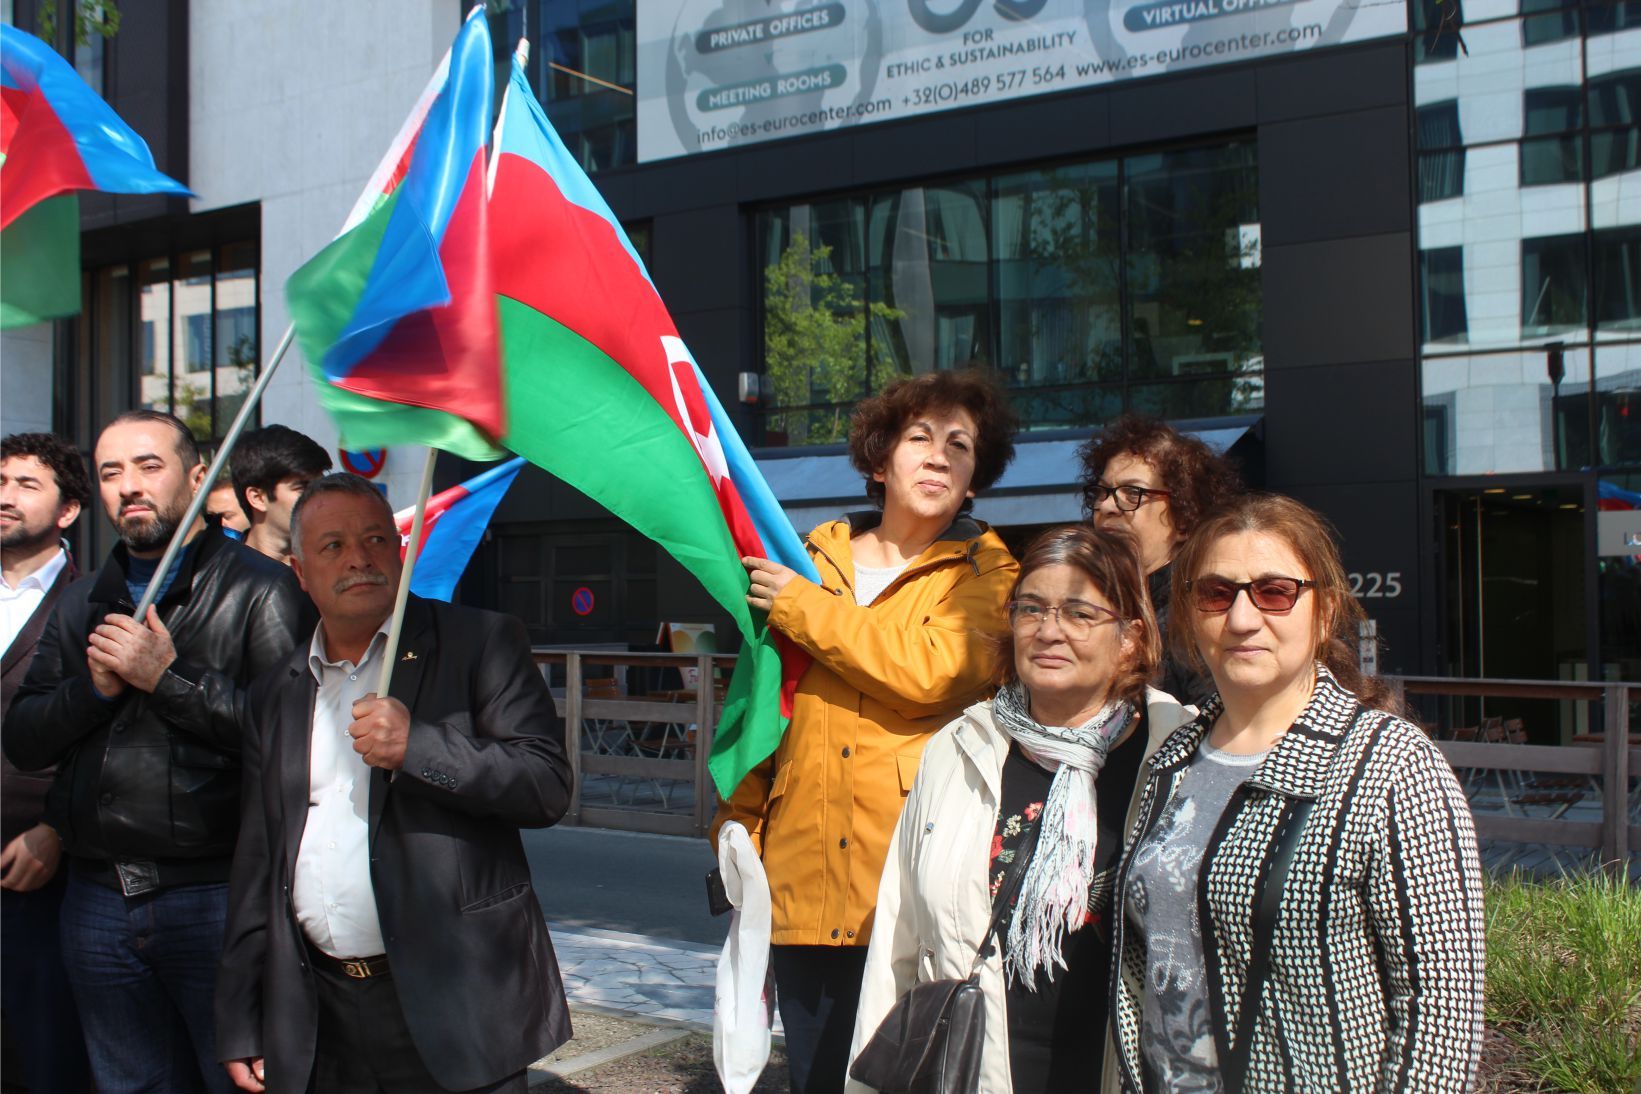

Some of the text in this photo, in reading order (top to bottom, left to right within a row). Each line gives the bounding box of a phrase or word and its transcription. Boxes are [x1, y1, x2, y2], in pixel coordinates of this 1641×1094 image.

[710, 11, 829, 48] PRIVATE OFFICES
[1143, 0, 1218, 24] VIRTUAL
[886, 30, 1077, 79] ETHIC & SUSTAINABILITY
[963, 28, 994, 46] FOR
[697, 98, 892, 145] info@es-eurocenter.com
[996, 69, 1027, 91] 577
[1032, 64, 1066, 85] 564
[1076, 22, 1323, 77] www.es-eurocenter.com
[709, 71, 832, 107] MEETING ROOMS
[1348, 572, 1402, 598] 225
